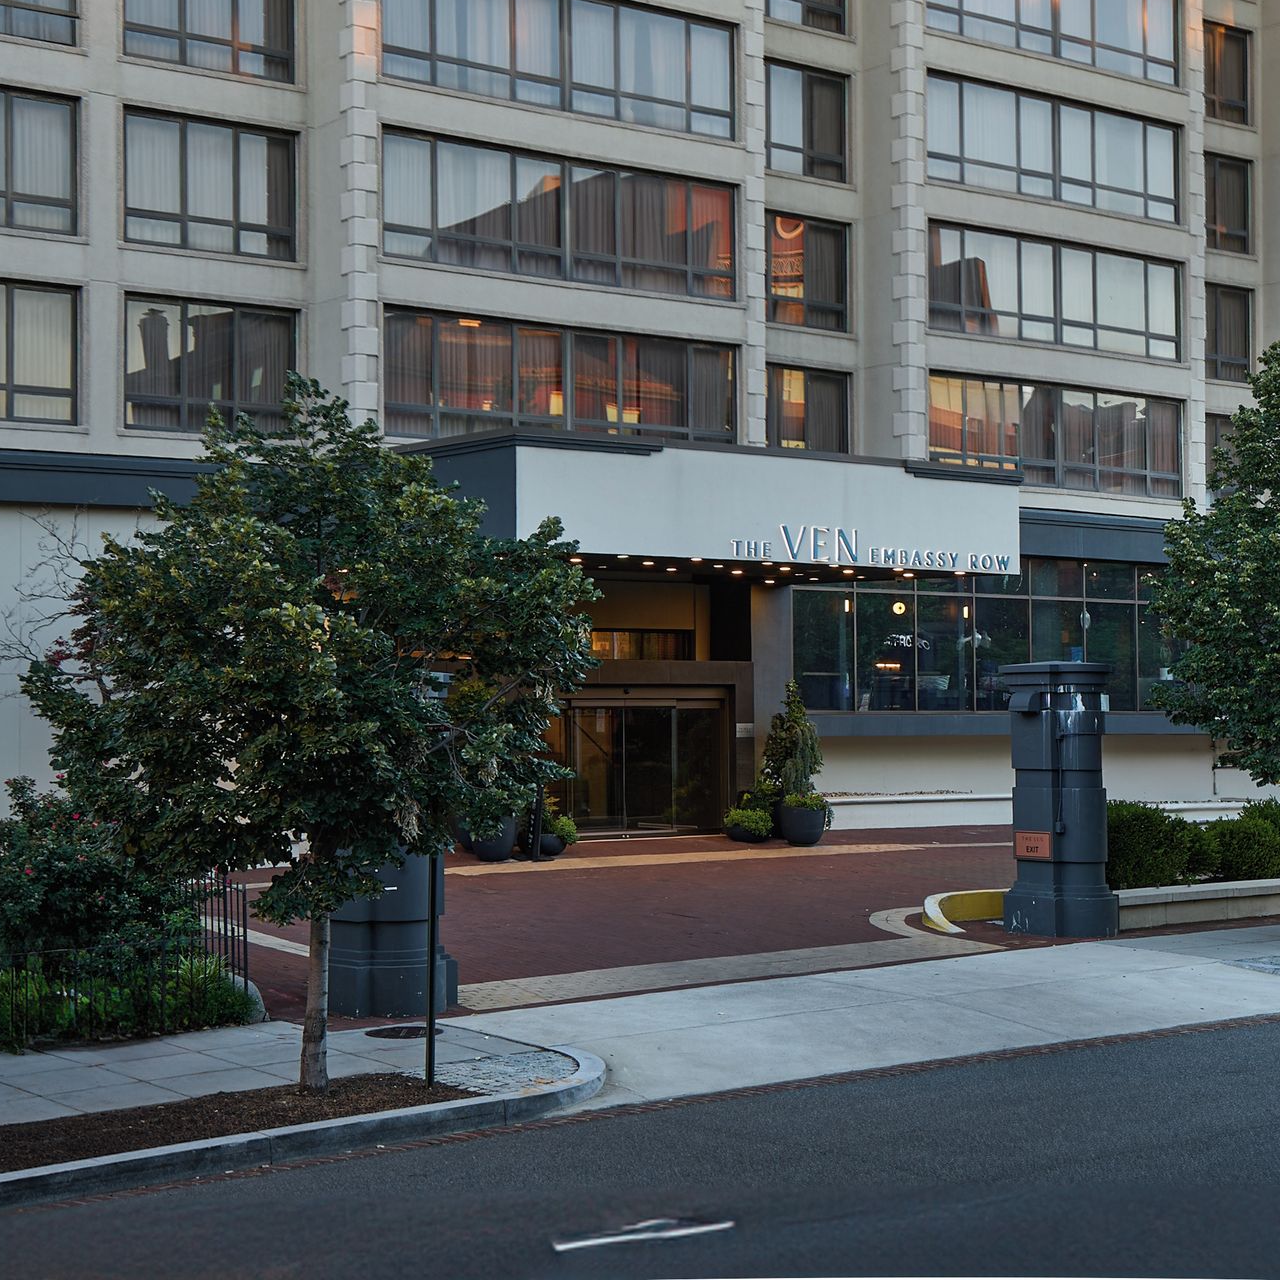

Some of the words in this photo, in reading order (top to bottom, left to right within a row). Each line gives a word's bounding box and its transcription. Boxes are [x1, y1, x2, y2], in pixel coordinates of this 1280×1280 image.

[730, 538, 772, 558] THE
[779, 523, 858, 563] VEN
[868, 547, 959, 568] EMBASSY
[968, 552, 1011, 571] ROW
[1026, 845, 1039, 853] EXIT
